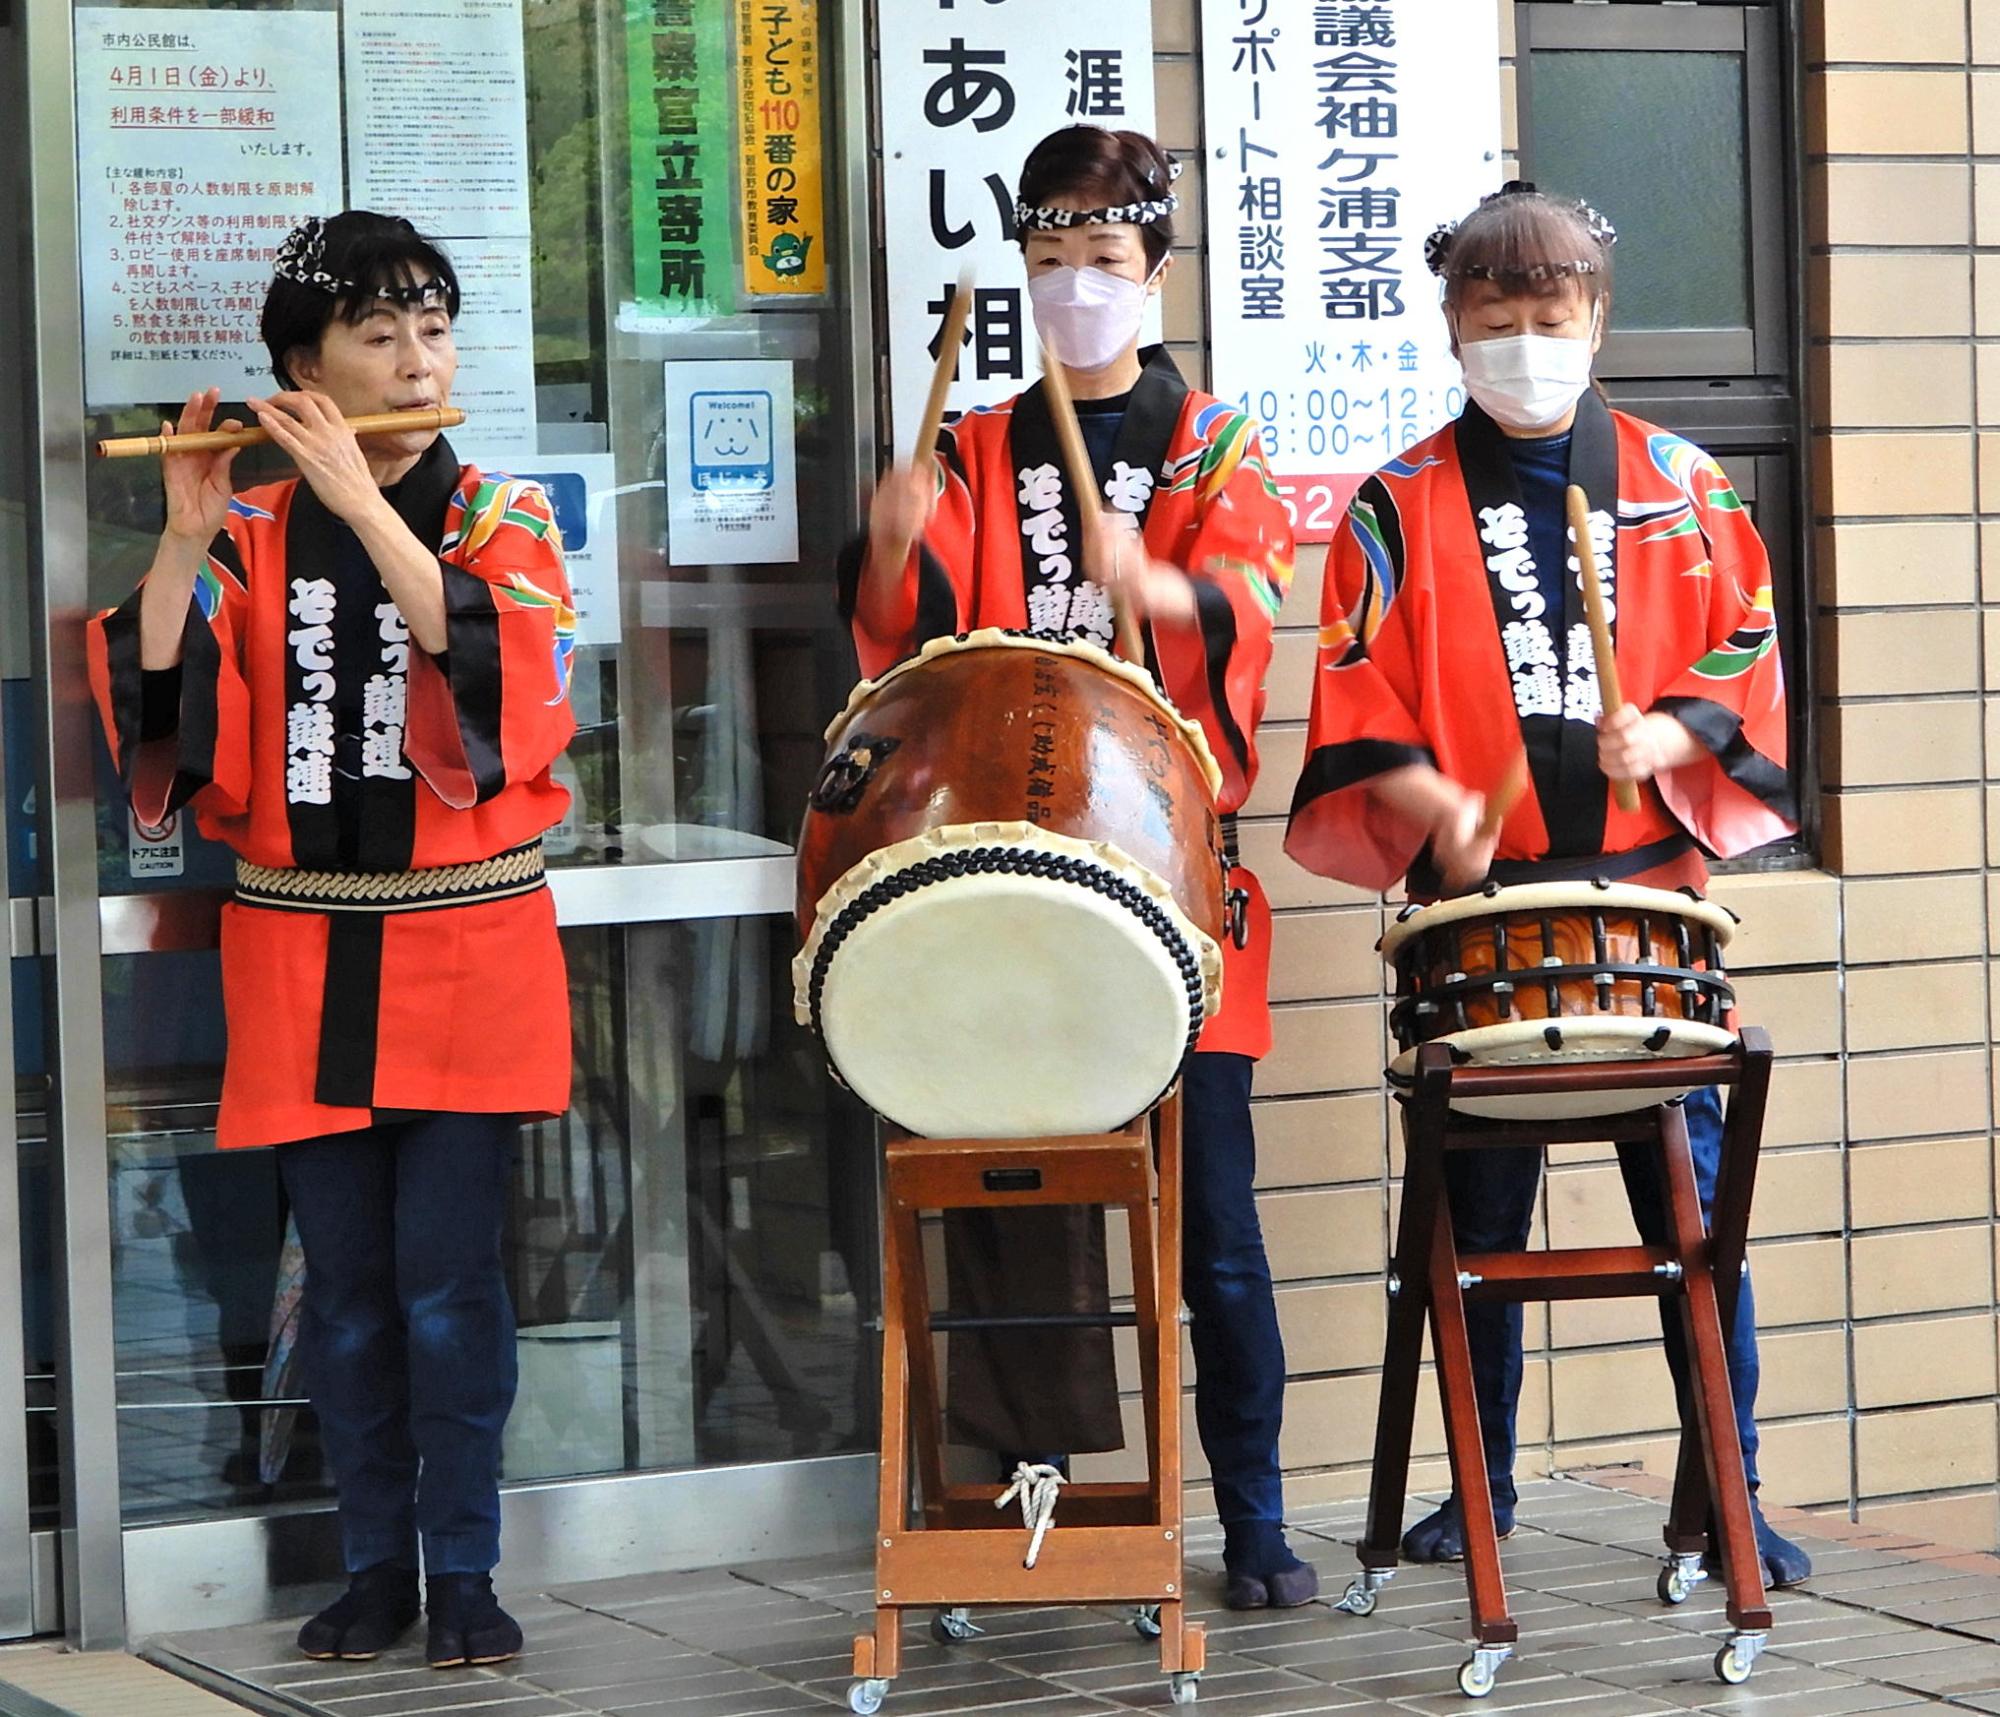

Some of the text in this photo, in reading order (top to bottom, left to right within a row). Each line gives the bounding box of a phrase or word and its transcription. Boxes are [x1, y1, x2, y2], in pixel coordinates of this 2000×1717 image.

[102, 33, 199, 49] 市内公民館は、
[1064, 48, 1125, 117] 涯
[110, 105, 276, 126] 利用条件を一部緩和
[759, 5, 801, 226] 子ども110番の家
[240, 142, 314, 157] いたします。
[1312, 0, 1406, 321] 議会袖ケ浦支部
[123, 197, 182, 213] 除します。
[922, 0, 1025, 423] あい相
[124, 231, 254, 246] 件付きで解除します。
[126, 264, 199, 279] 再開します。
[708, 401, 755, 410] Welcome!
[1239, 386, 1464, 422] 10:00~12:0
